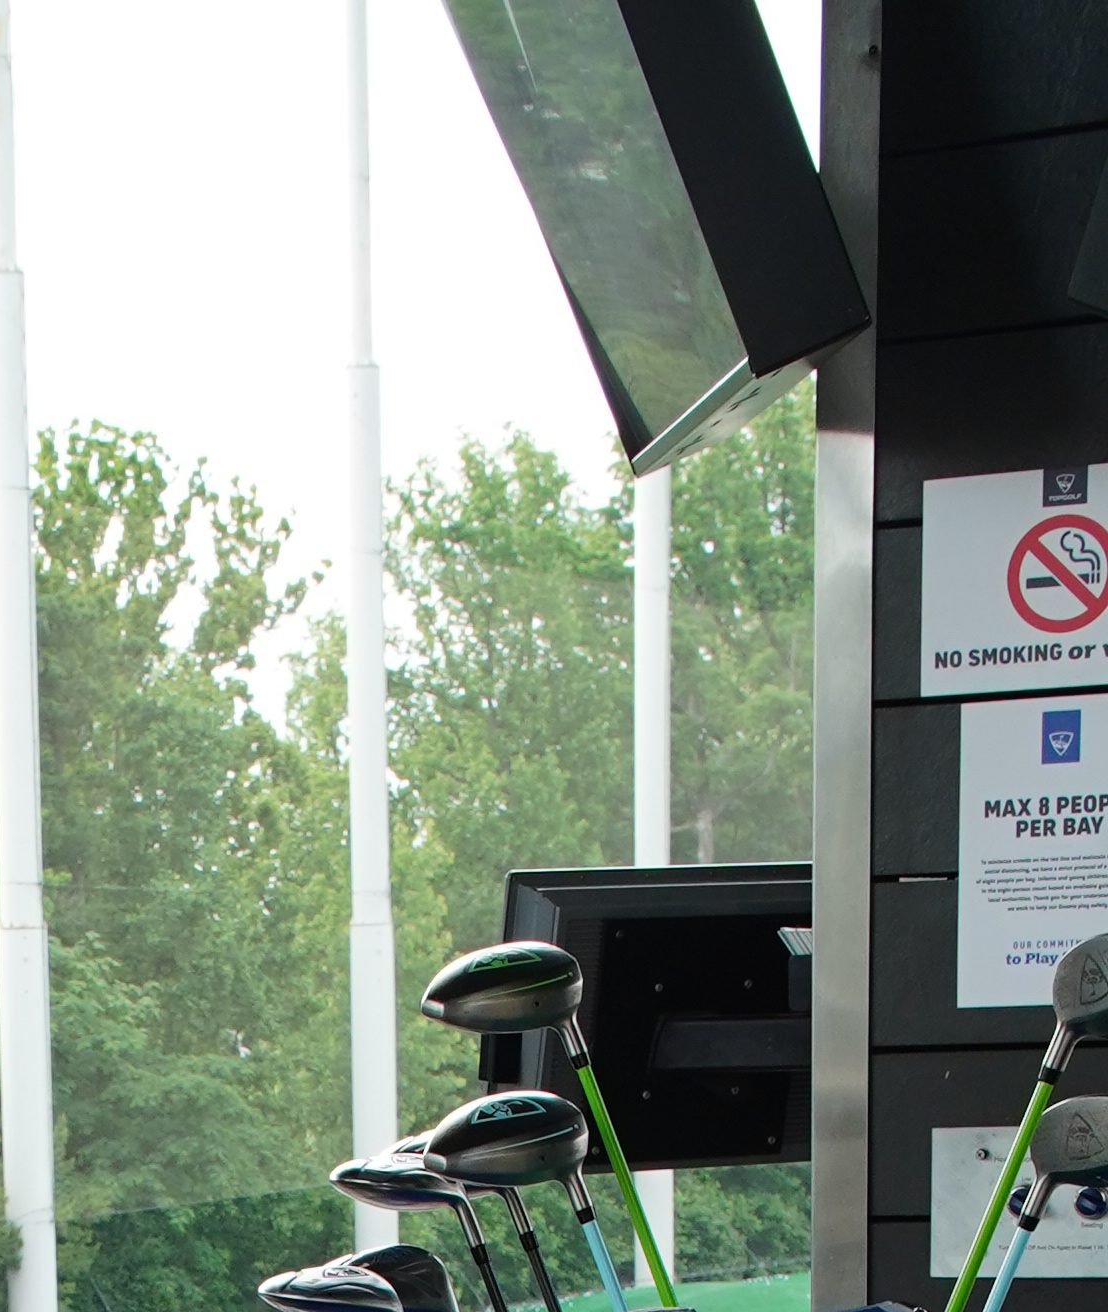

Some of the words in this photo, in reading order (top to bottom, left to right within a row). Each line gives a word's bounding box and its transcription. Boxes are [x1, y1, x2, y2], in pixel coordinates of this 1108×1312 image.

[1049, 493, 1082, 501] TOPGOLF
[935, 651, 962, 669] NO
[968, 643, 1062, 667] SMOKING
[1068, 644, 1097, 660] or
[984, 798, 1031, 818] MAX
[1039, 797, 1049, 816] 8
[1016, 819, 1056, 838] PER
[1063, 816, 1104, 836] BAY
[1013, 941, 1031, 950] OUR
[1006, 954, 1021, 965] to
[1024, 952, 1059, 967] Play
